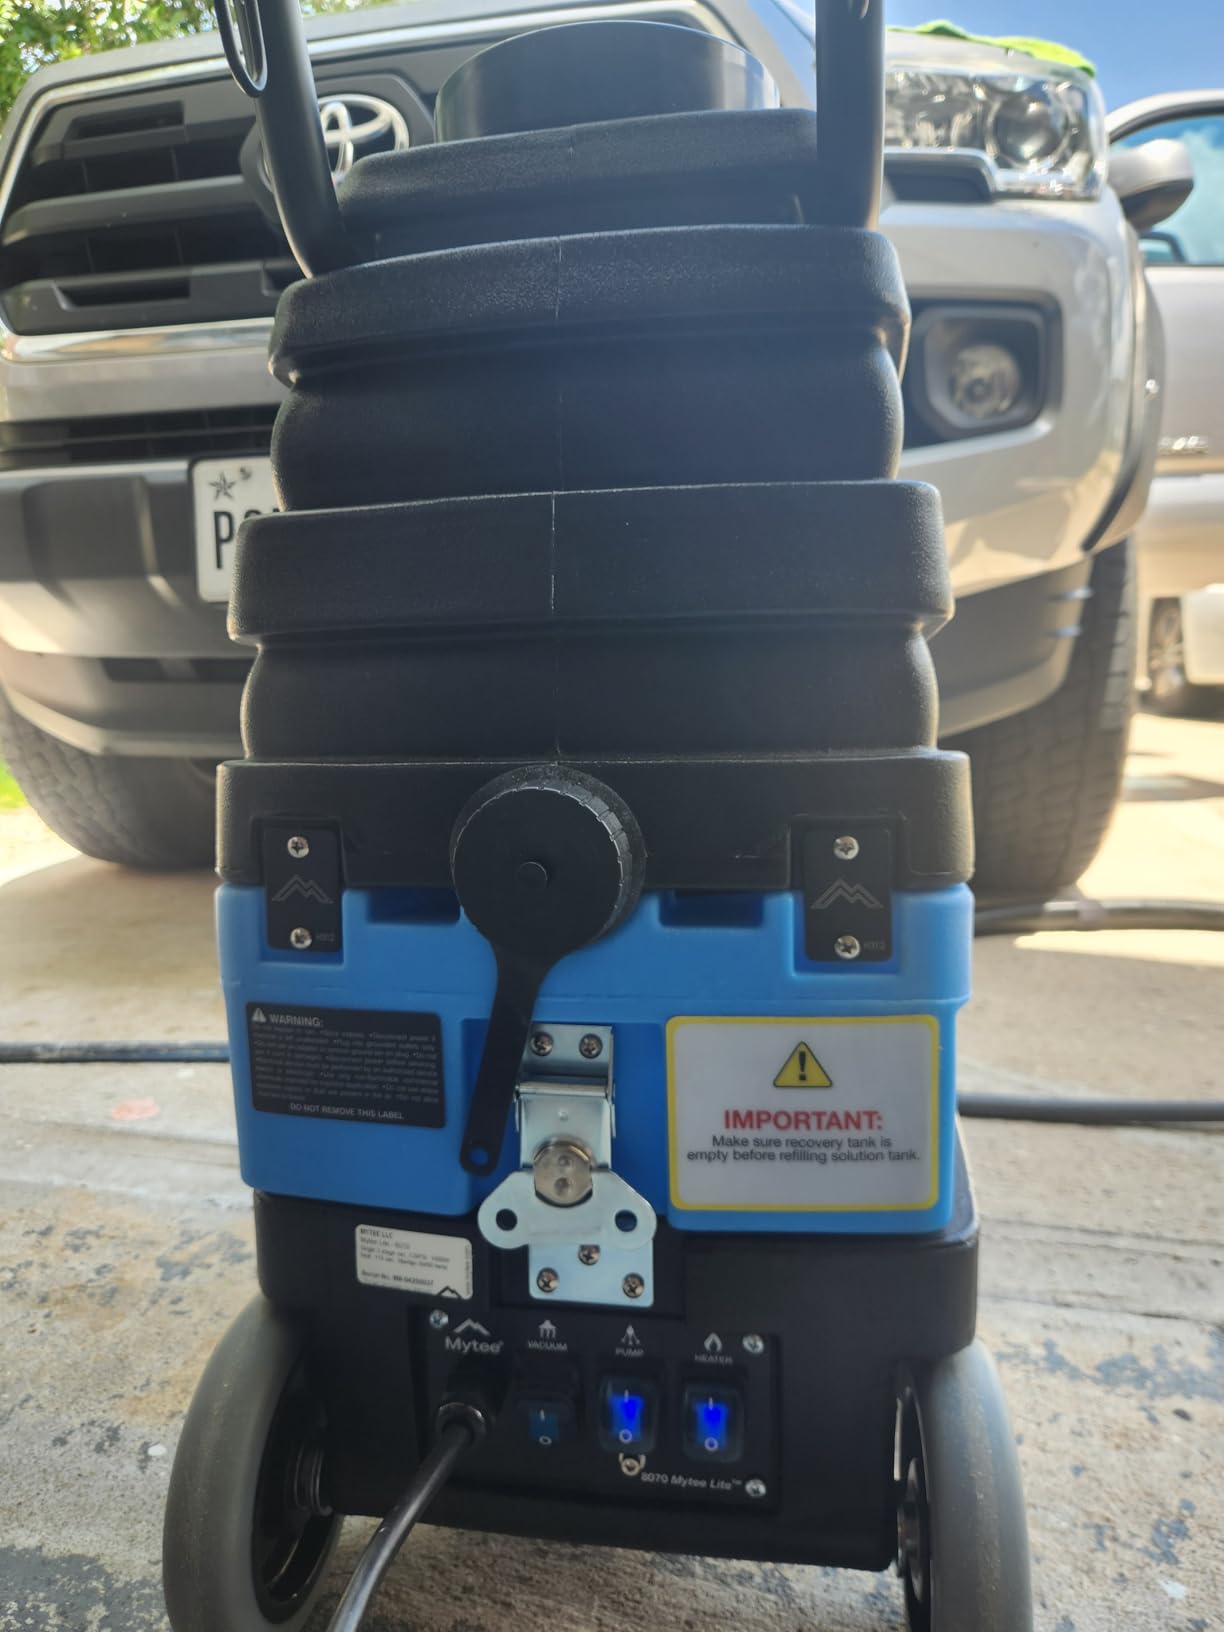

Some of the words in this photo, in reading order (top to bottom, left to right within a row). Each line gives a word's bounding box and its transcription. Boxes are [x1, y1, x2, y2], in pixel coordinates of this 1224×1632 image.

[269, 1013, 324, 1028] WARNING:
[290, 1103, 303, 1112] DO
[303, 1104, 320, 1113] NOT
[322, 1105, 355, 1116] REMOVE
[357, 1108, 376, 1118] THIS
[378, 1109, 405, 1120] LABEL
[724, 1109, 883, 1131] IMPORTANT:
[712, 1135, 749, 1148] Make
[753, 1138, 782, 1148] sure
[785, 1138, 842, 1152] recovery
[847, 1136, 876, 1148] tank
[880, 1136, 892, 1148] is
[687, 1149, 728, 1164] empty
[733, 1149, 777, 1161] before
[780, 1149, 828, 1165] refilling
[831, 1149, 884, 1162] solution
[888, 1149, 920, 1162] tank.
[527, 1339, 568, 1352] VACUUM
[640, 1471, 669, 1484] 8070
[670, 1474, 707, 1488] Mytee
